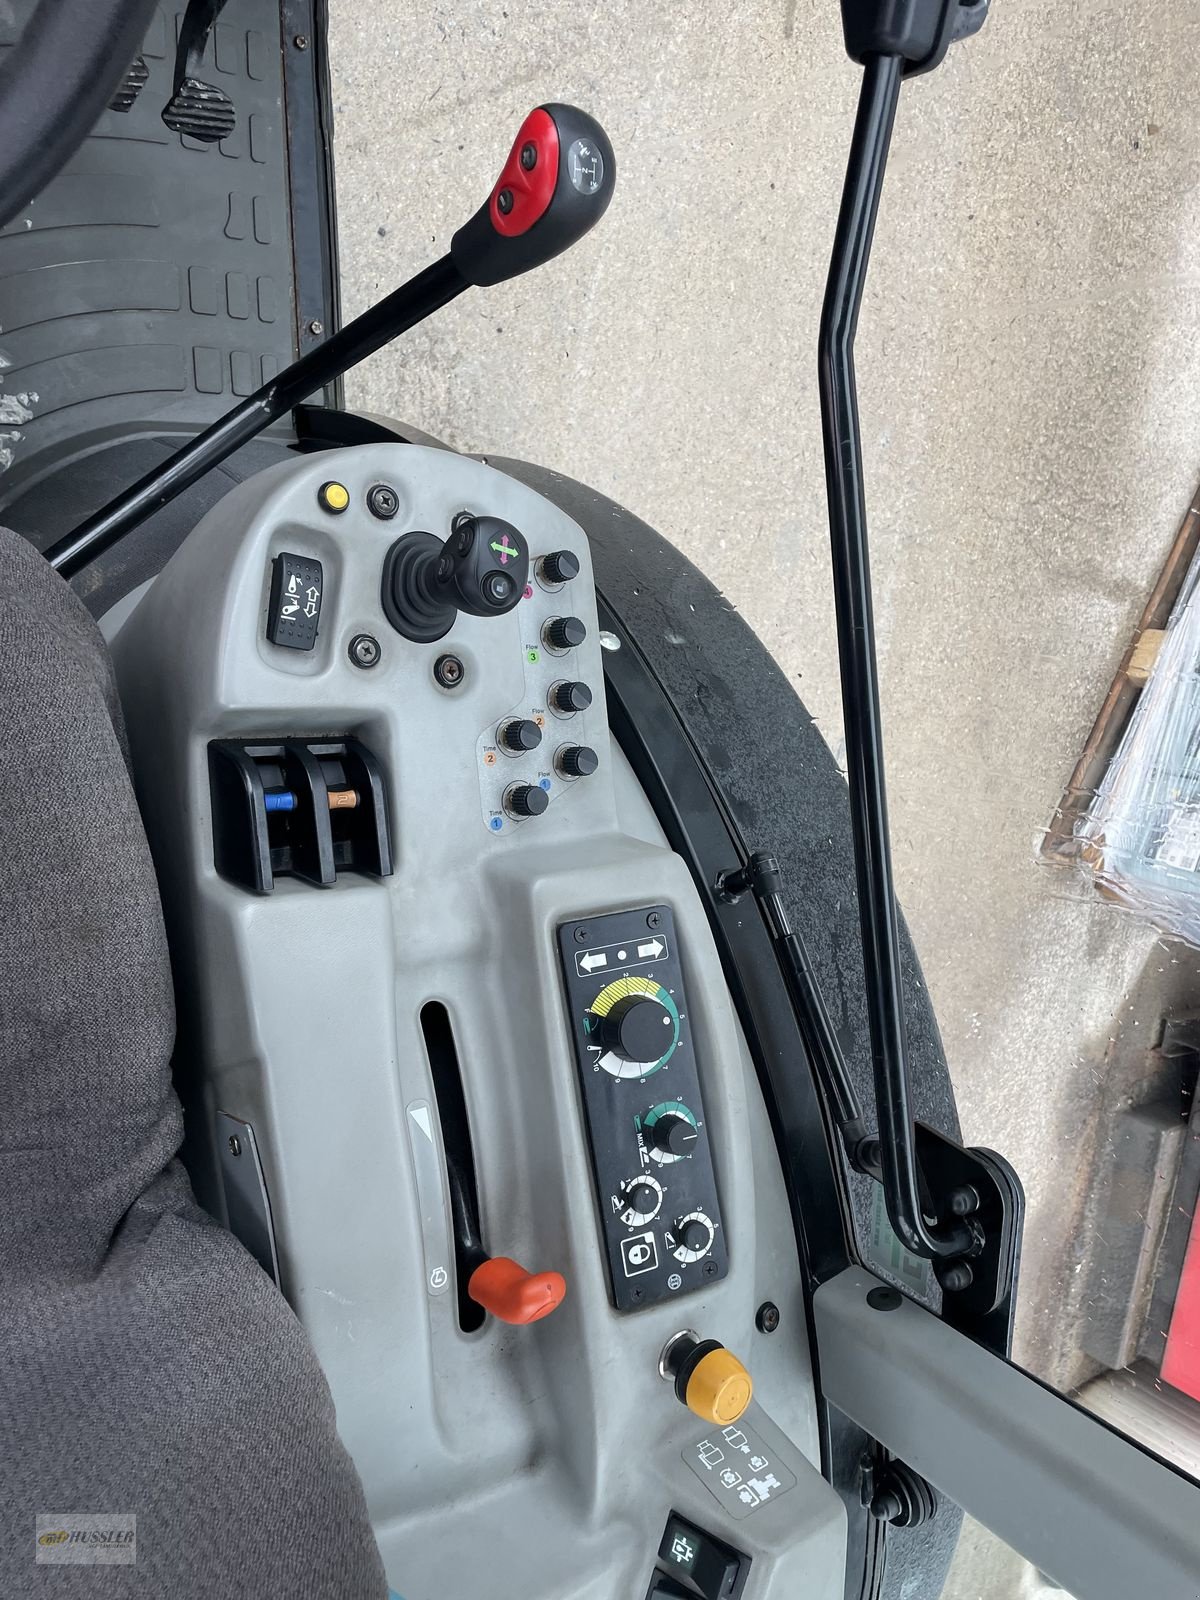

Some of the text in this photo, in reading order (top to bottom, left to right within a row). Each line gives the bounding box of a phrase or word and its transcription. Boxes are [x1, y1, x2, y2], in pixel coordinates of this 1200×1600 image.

[530, 652, 536, 660] 3
[594, 1063, 600, 1072] 10
[636, 1133, 644, 1146] MIX
